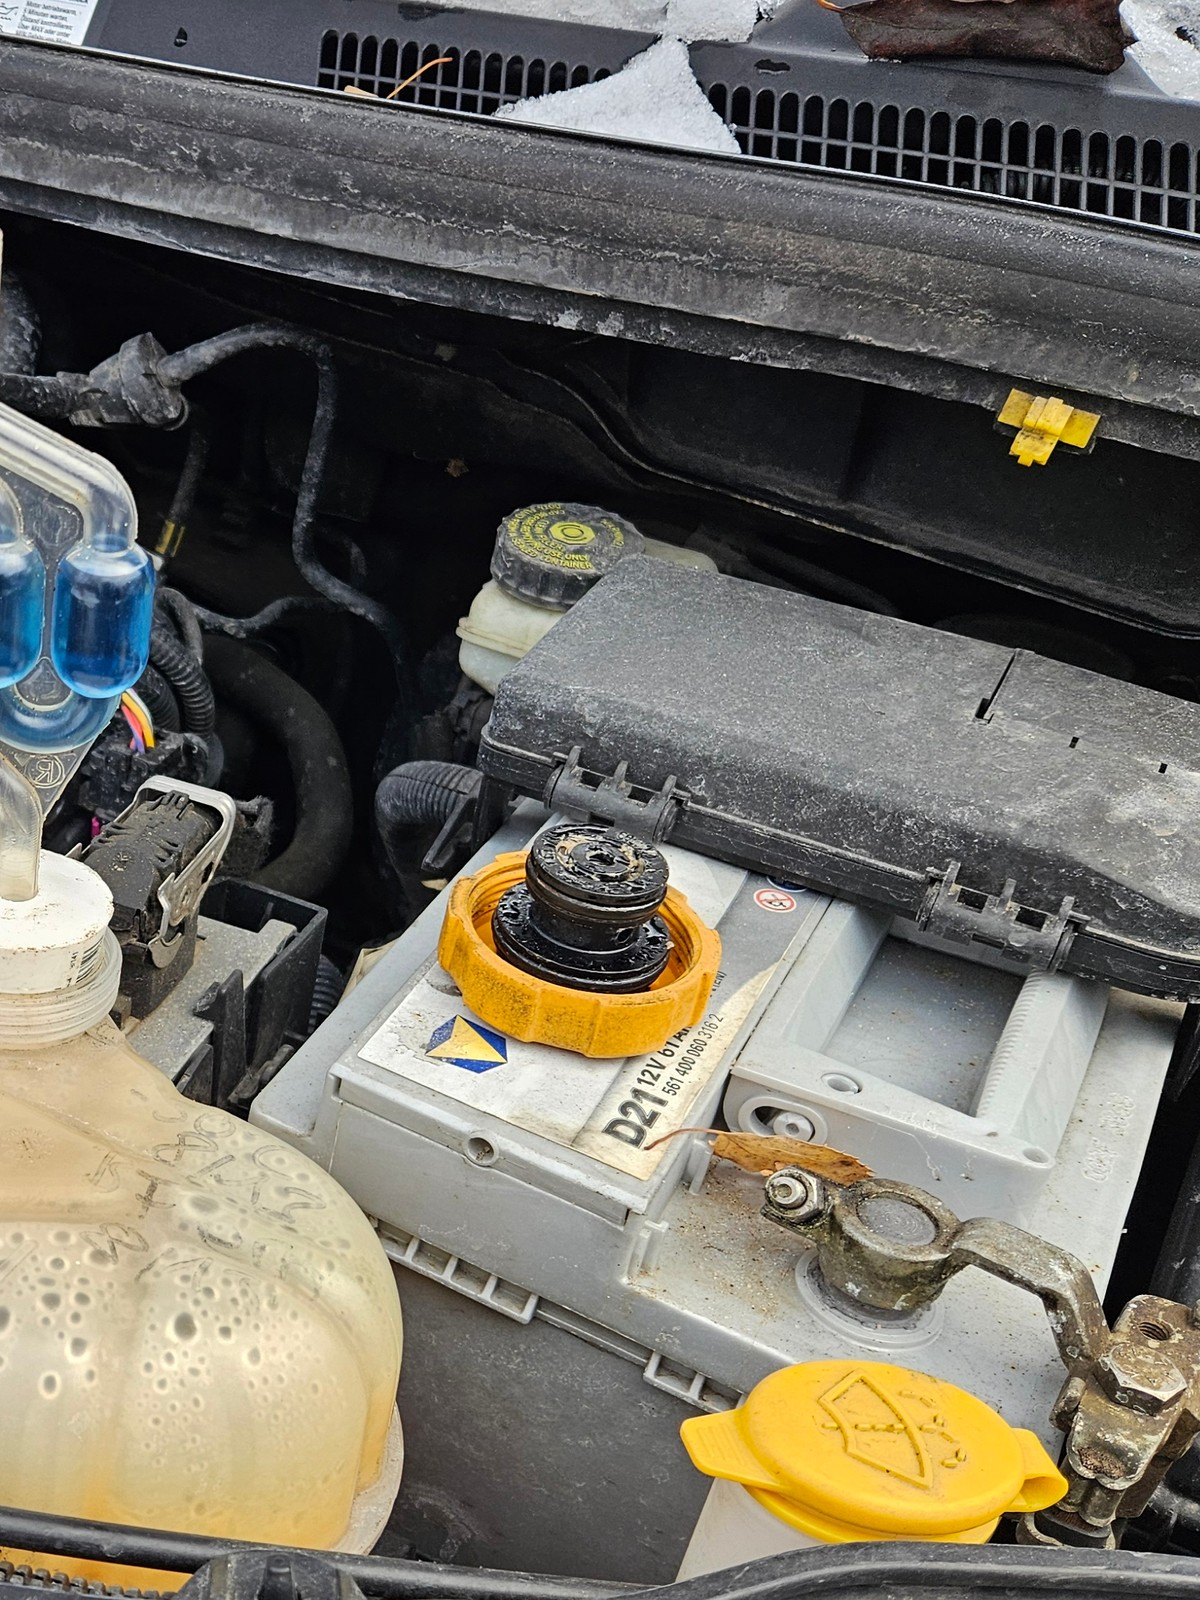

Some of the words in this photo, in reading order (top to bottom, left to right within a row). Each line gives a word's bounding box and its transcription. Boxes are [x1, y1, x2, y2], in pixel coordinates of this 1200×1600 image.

[539, 555, 593, 570] CONTAINER
[565, 553, 590, 562] ONLY
[709, 1013, 723, 1023] 2
[698, 1022, 718, 1040] 316
[690, 1039, 708, 1057] 060
[637, 1057, 666, 1087] 12V
[675, 1056, 696, 1077] 400
[662, 1076, 685, 1096] 561
[602, 1087, 668, 1150] D21
